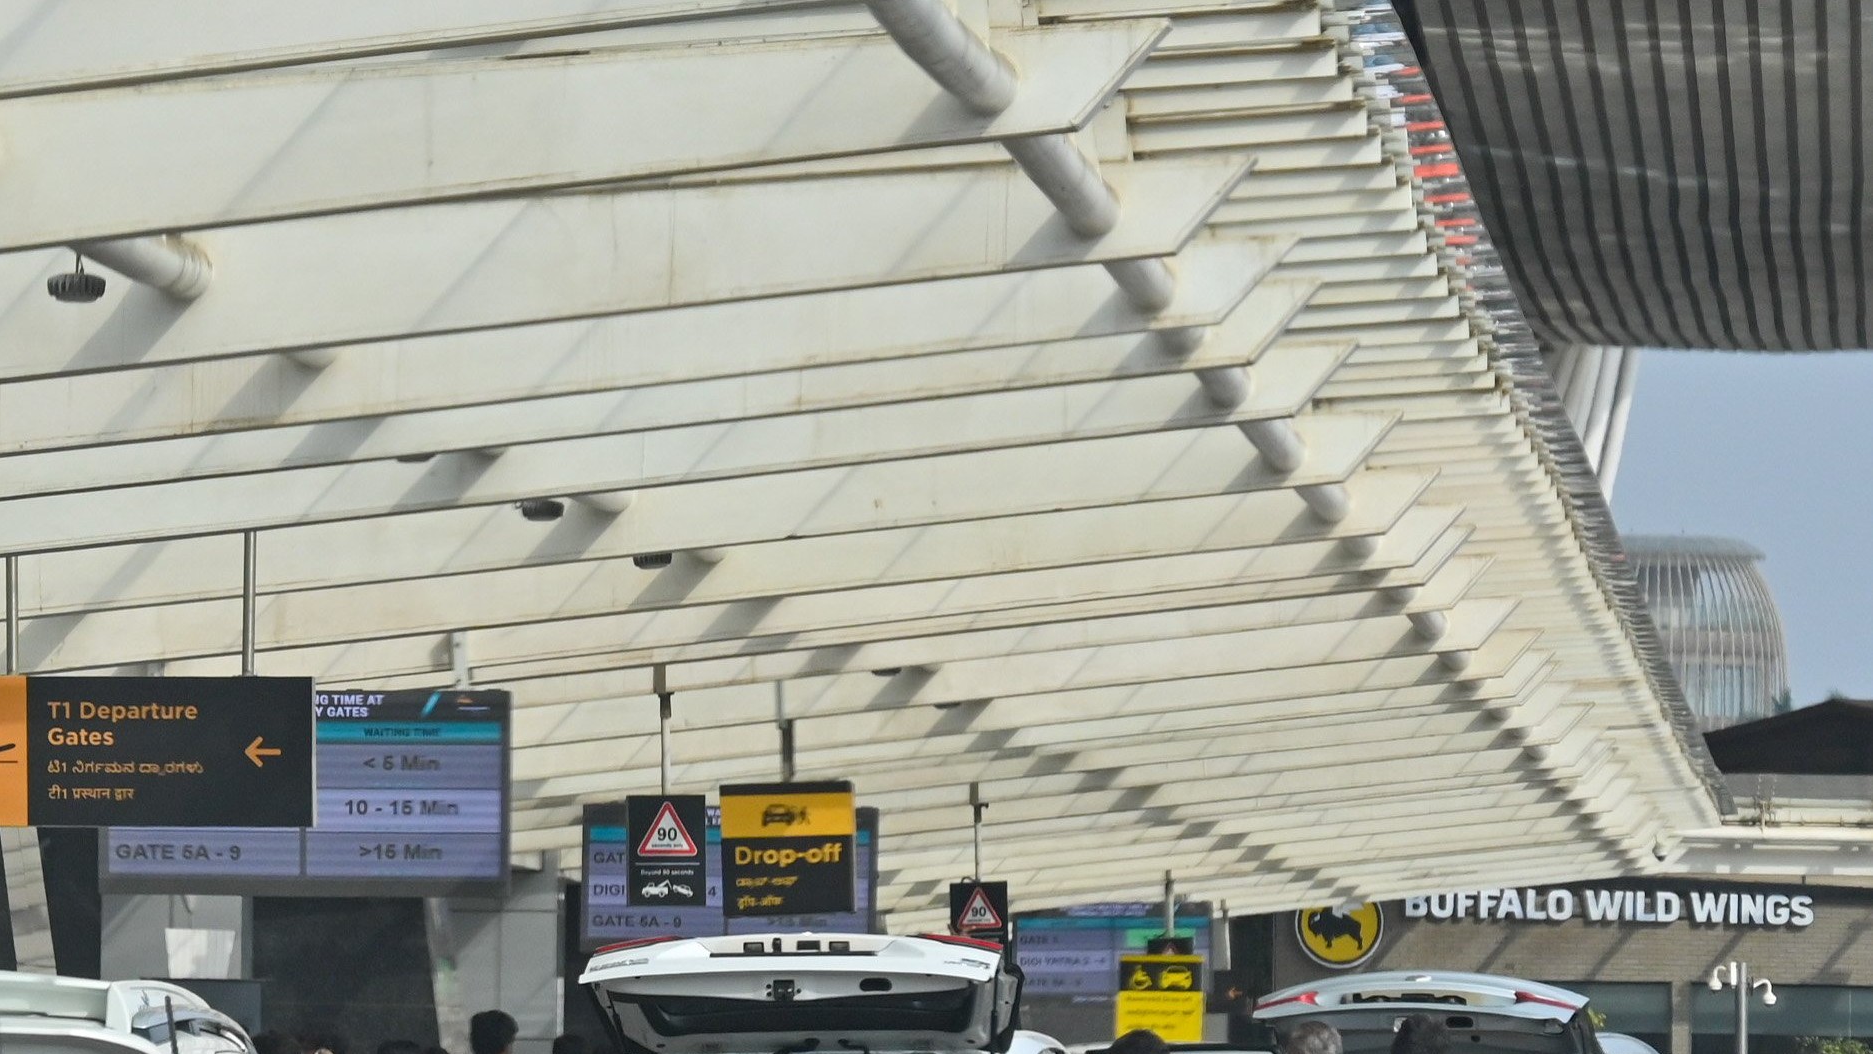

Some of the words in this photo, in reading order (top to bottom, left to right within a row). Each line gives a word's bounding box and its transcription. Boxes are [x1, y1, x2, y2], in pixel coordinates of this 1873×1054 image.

[331, 694, 364, 705] TIME
[366, 694, 384, 705] AT
[47, 701, 71, 720] T1
[79, 701, 198, 722] Departure
[327, 706, 369, 717] GATES
[47, 727, 115, 746] Gates
[345, 800, 368, 815] 10
[657, 827, 677, 841] 90
[115, 844, 175, 860] GATE
[229, 845, 241, 861] 9
[593, 852, 625, 864] GAT
[734, 843, 843, 867] Drop-off
[971, 907, 987, 918] 90
[1405, 888, 1574, 922] BUFFALO
[1584, 889, 1681, 923] WILD
[1690, 891, 1815, 928] WINGS
[592, 915, 634, 928] GATE
